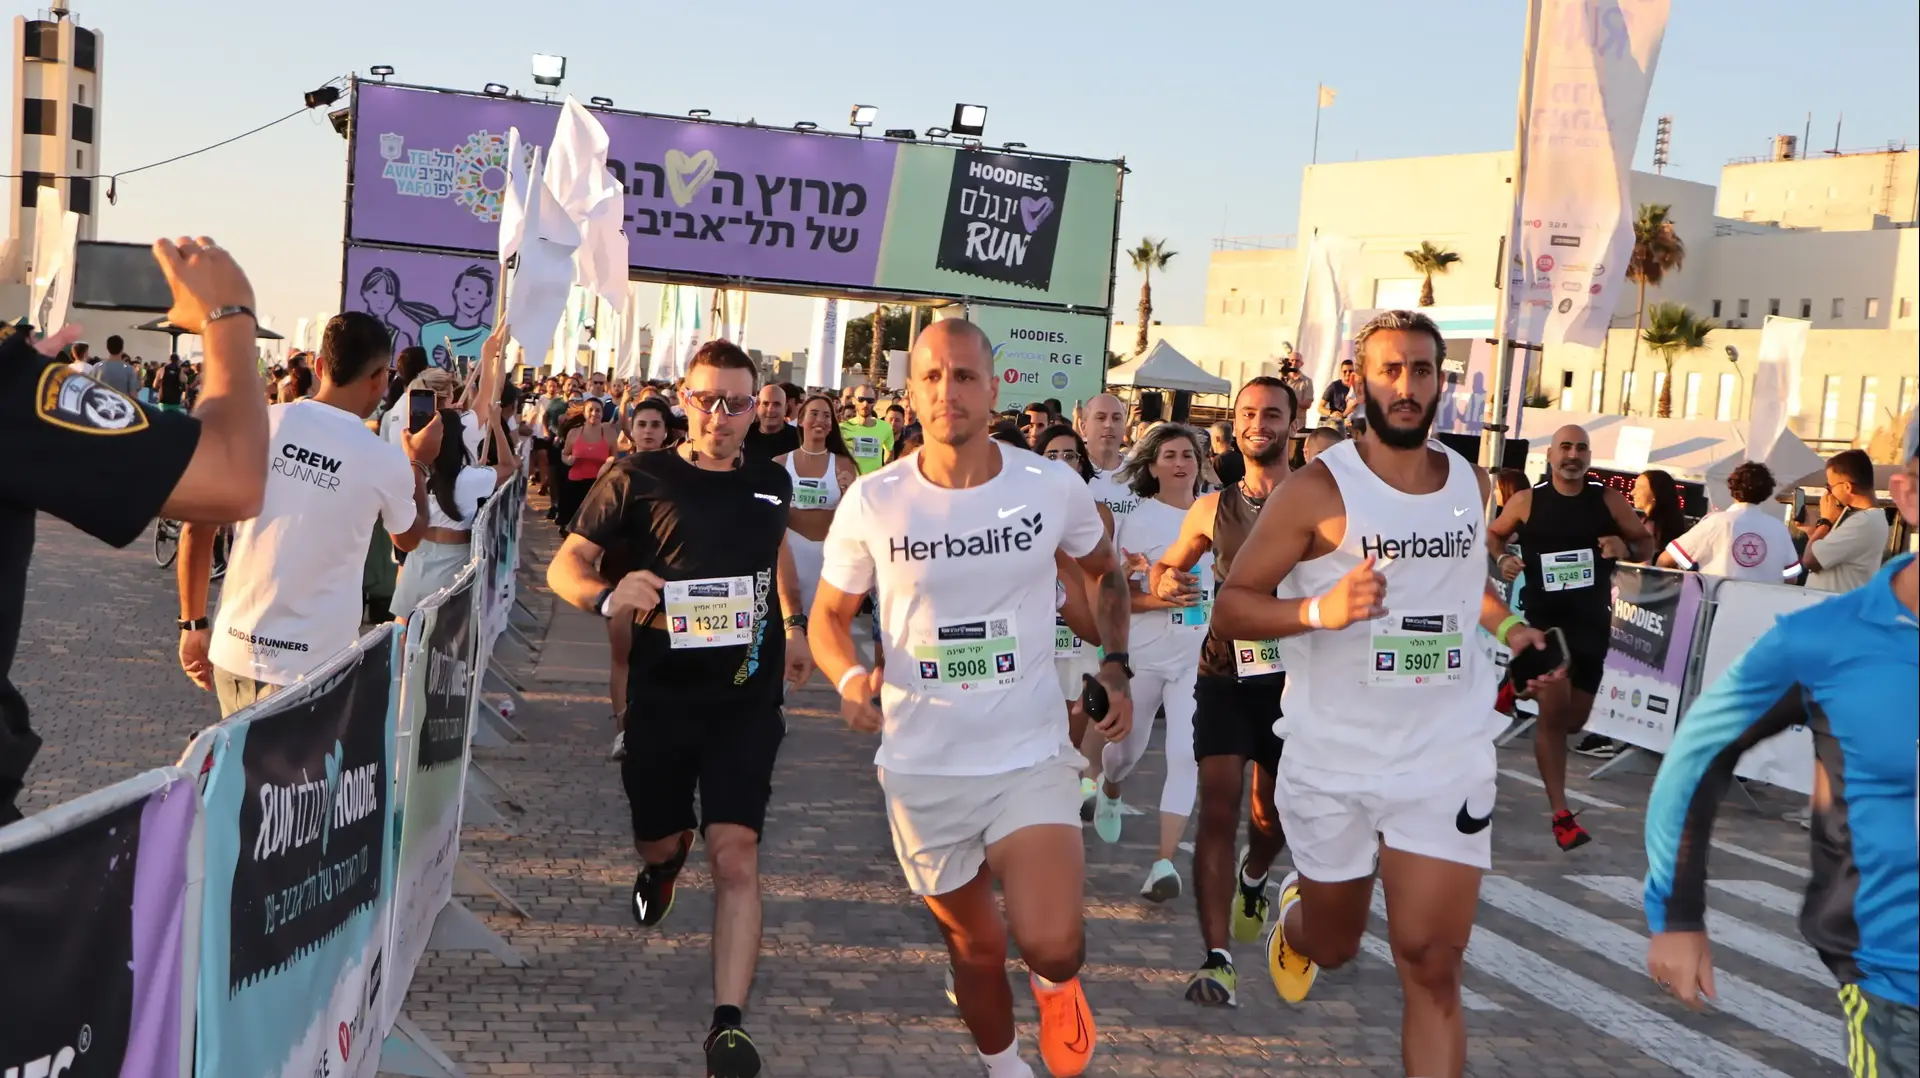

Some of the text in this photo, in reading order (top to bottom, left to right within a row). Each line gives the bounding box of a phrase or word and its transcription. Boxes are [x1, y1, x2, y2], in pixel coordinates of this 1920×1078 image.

[385, 164, 417, 178] AVIV
[410, 152, 432, 165] TEL
[397, 179, 432, 194] YAFO
[434, 183, 453, 196] יפו
[755, 174, 867, 216] מרוץ
[959, 185, 1018, 224] ינגלם
[624, 208, 859, 253] של תל-אביב-
[965, 222, 1032, 268] RUN
[1004, 368, 1039, 383] ynet
[282, 443, 343, 475] CREW
[271, 457, 341, 492] RUNNER
[889, 526, 1033, 562] Herbalife
[1361, 530, 1471, 560] Herbalife
[695, 615, 728, 631] 1322
[228, 626, 309, 652] ADIDAS RUNNERS
[259, 647, 281, 658] AVIV
[948, 659, 987, 678] 5908
[1404, 653, 1440, 670] 5907
[253, 782, 296, 863] RUN
[318, 860, 333, 904] של
